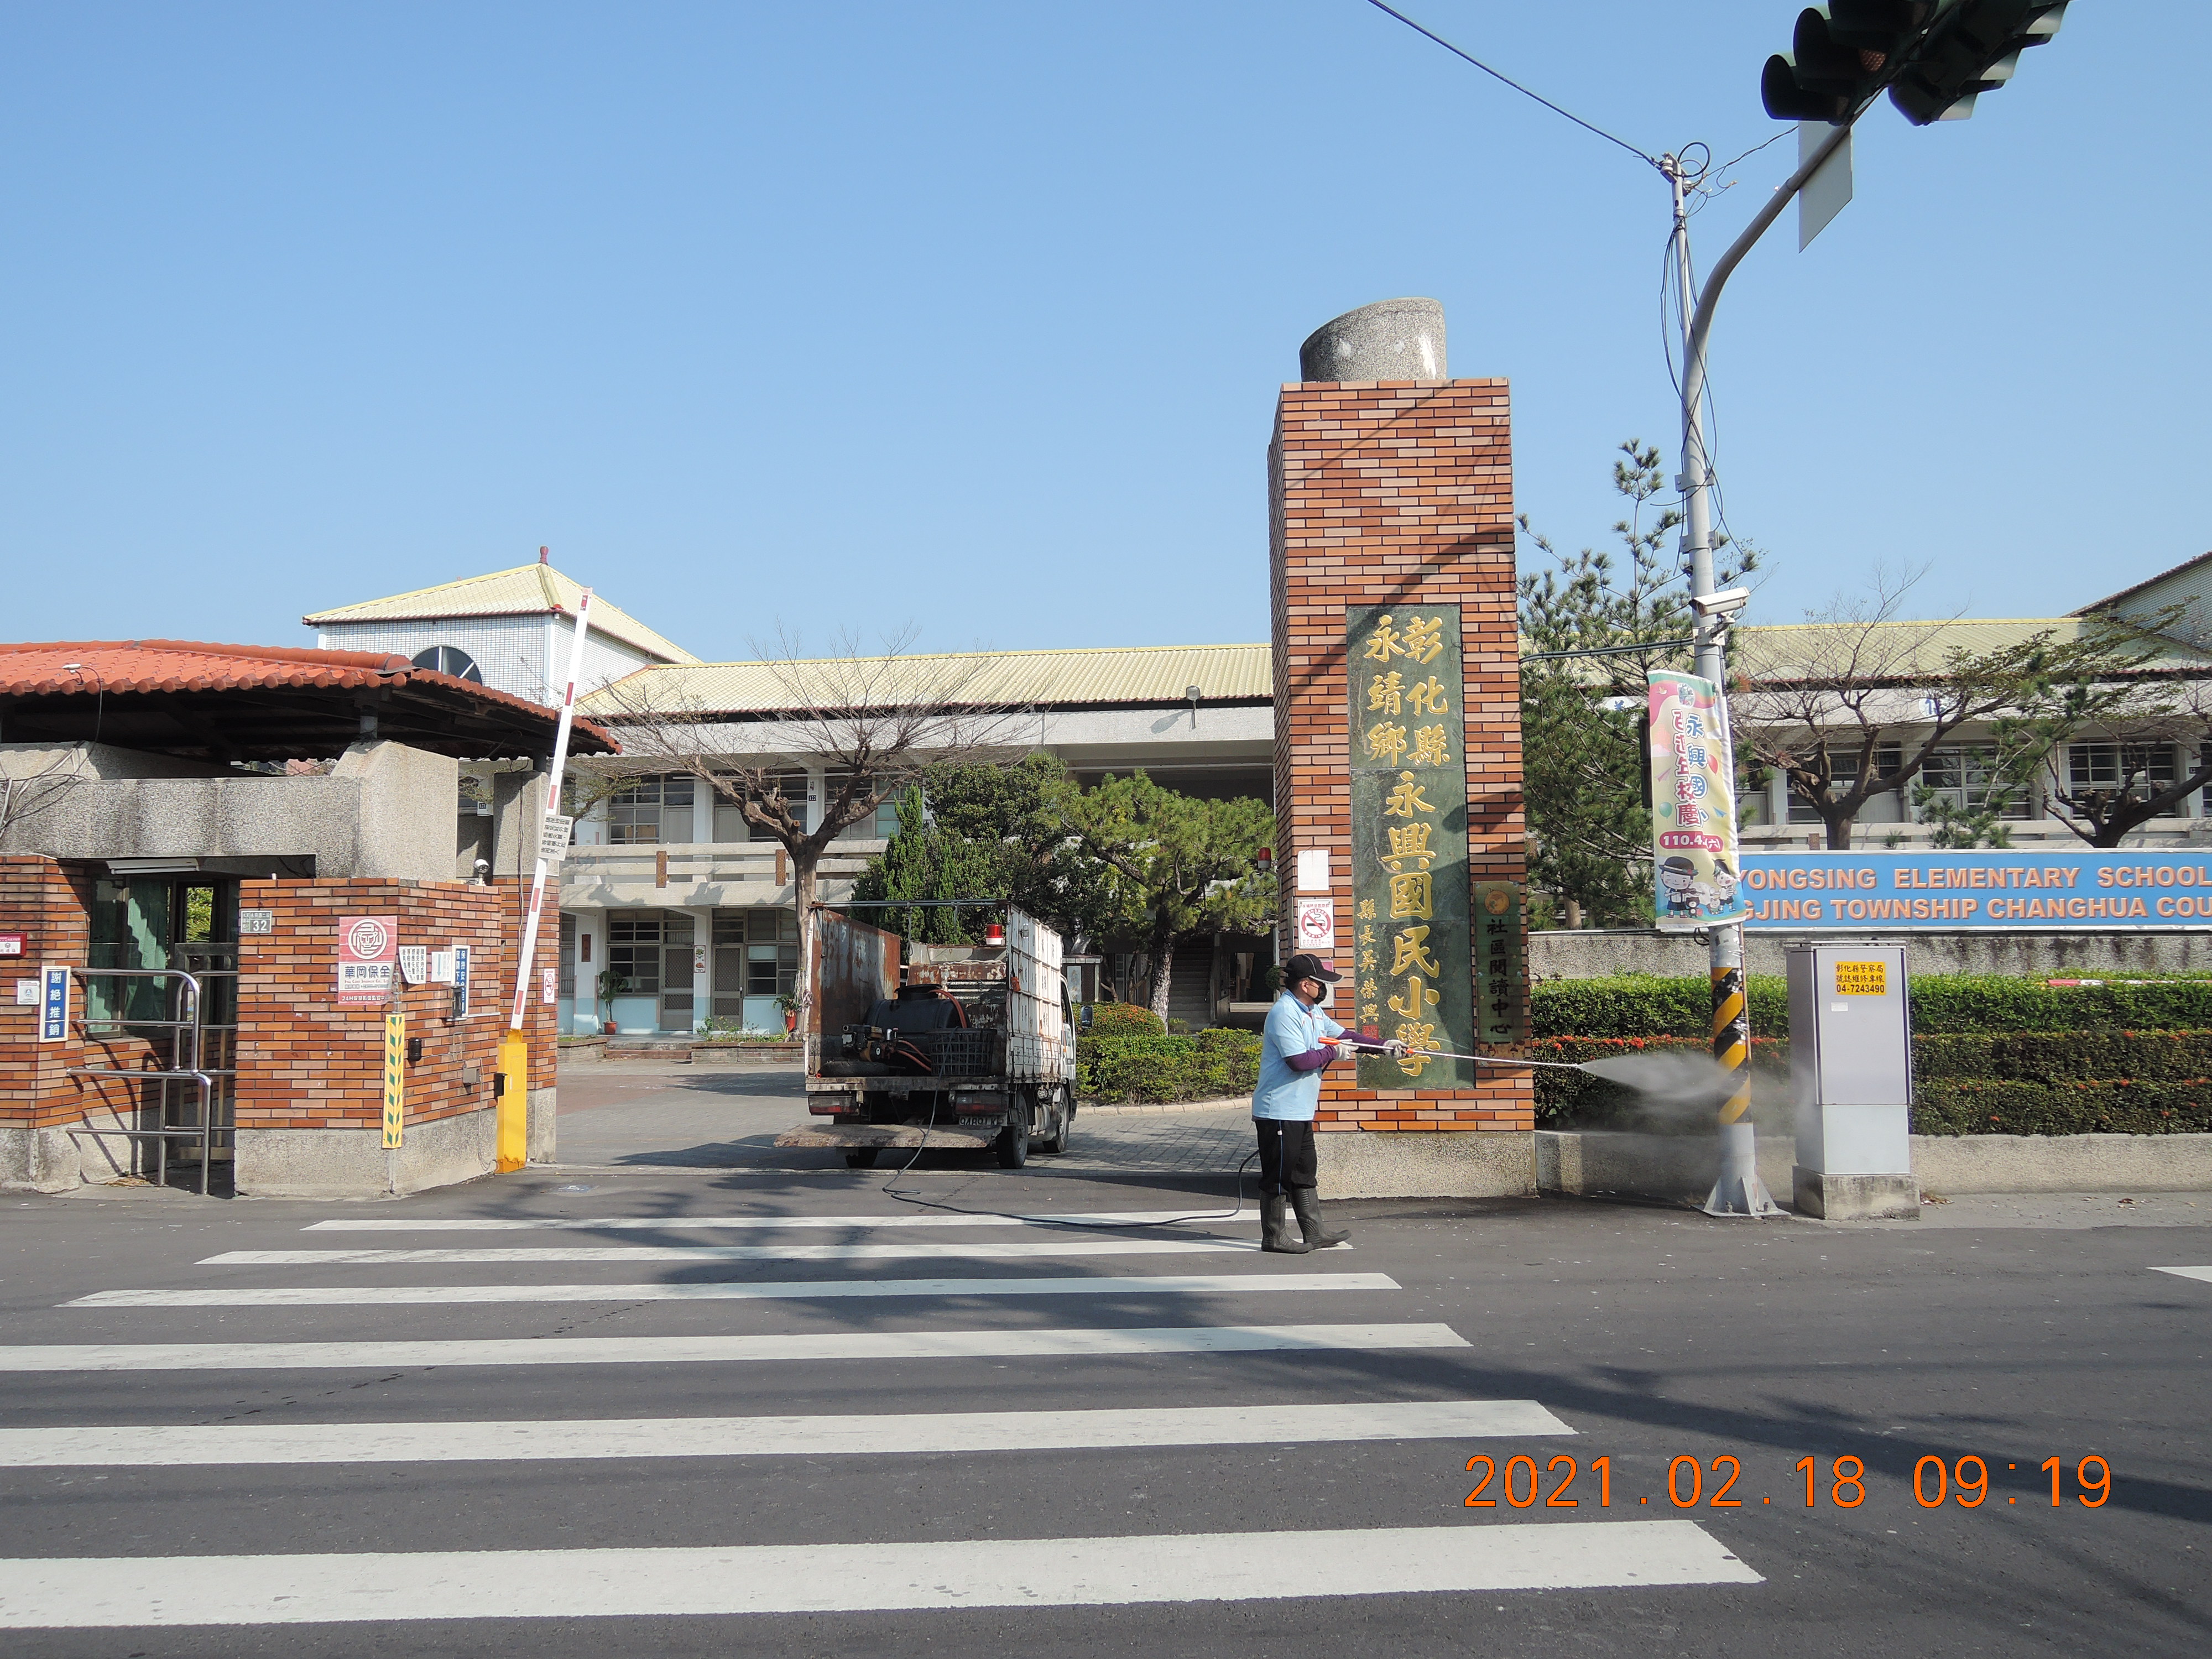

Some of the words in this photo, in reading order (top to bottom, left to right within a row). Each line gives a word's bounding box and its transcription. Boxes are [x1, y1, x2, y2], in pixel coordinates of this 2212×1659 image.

[1363, 614, 1407, 768] 永靖鄉
[1402, 615, 1450, 766] 彰化縣
[1830, 898, 1978, 920] TOWNSHIP
[1987, 898, 2148, 919] CHANGHUA
[1895, 868, 2080, 889] ELEMENTARY
[2098, 866, 2212, 887] SCHOOL
[253, 920, 267, 931] 32
[1381, 770, 1441, 1077] 永興國民小學
[49, 972, 62, 1036] 謝絕推銷
[345, 966, 390, 978] 華岡保全
[1357, 899, 1380, 1059] 縣長吳榮興
[1487, 919, 1512, 1035] 社區閱讀中心
[1837, 984, 1885, 993] 04-7243490
